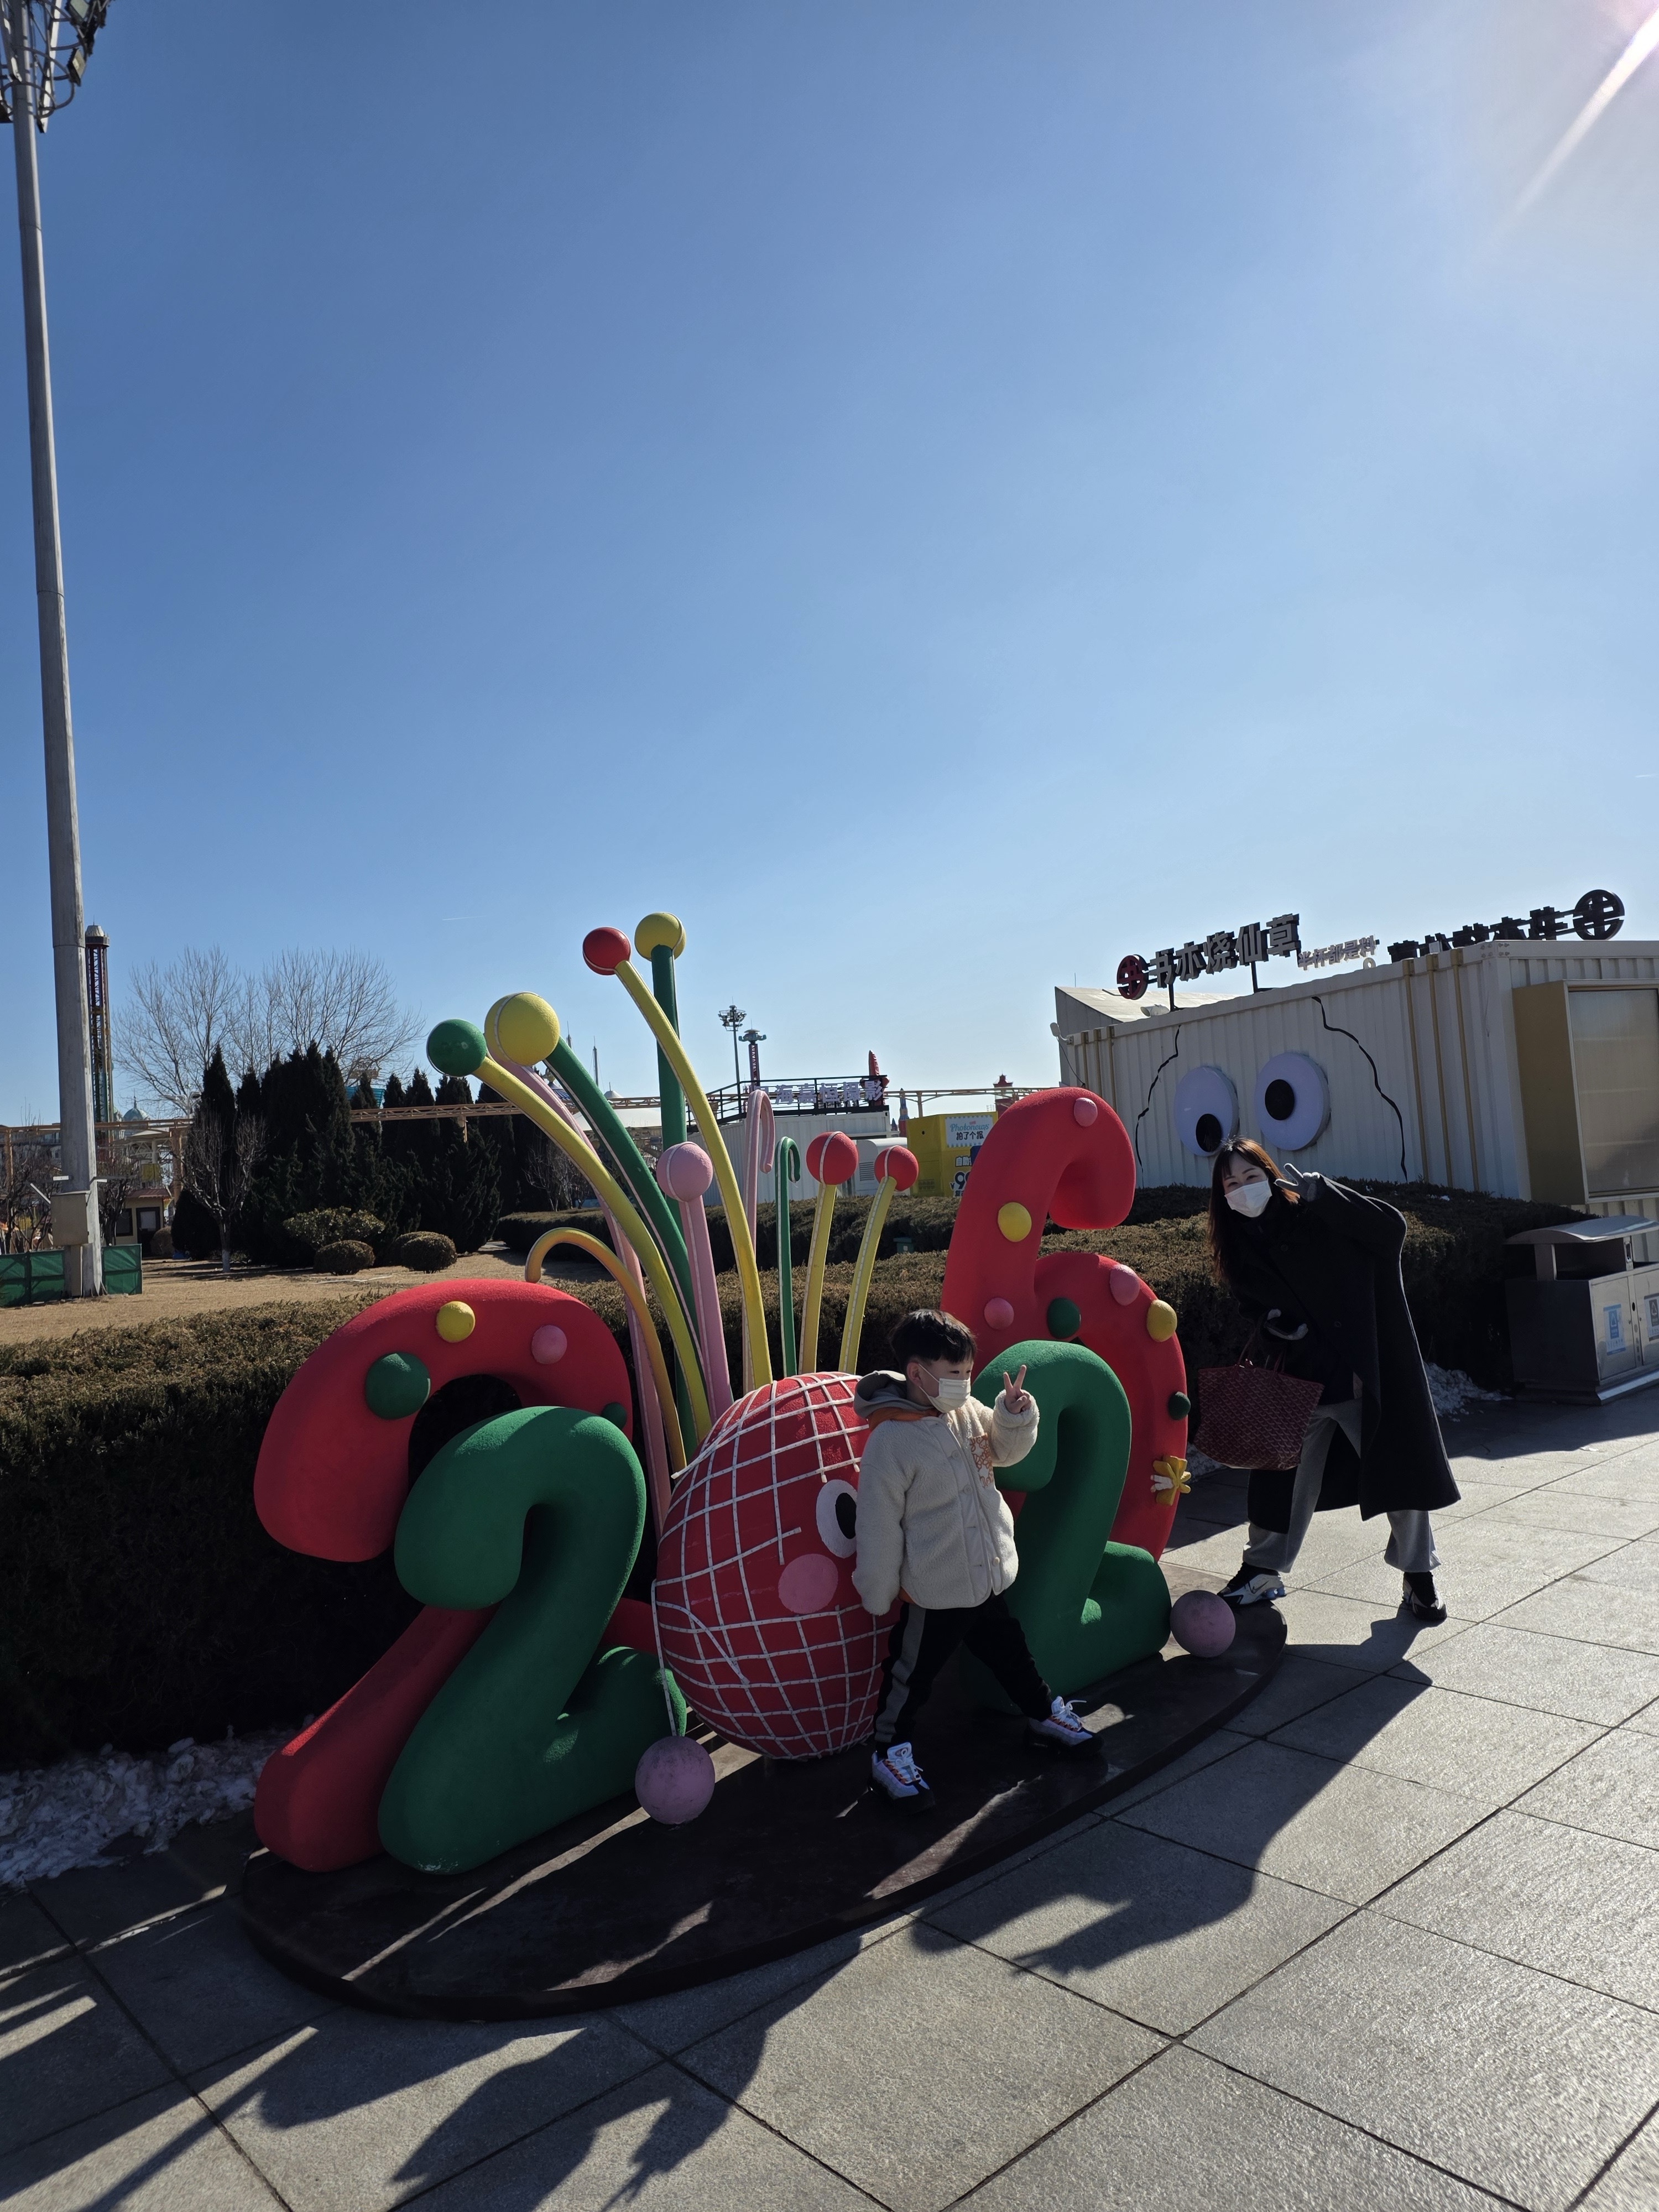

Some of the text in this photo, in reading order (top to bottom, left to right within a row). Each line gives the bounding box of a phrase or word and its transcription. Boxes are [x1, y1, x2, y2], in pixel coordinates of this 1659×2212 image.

[1149, 913, 1301, 989] 书亦烧仙草
[1298, 935, 1376, 971] 半杯都是料
[956, 1131, 984, 1140] 拍了个报
